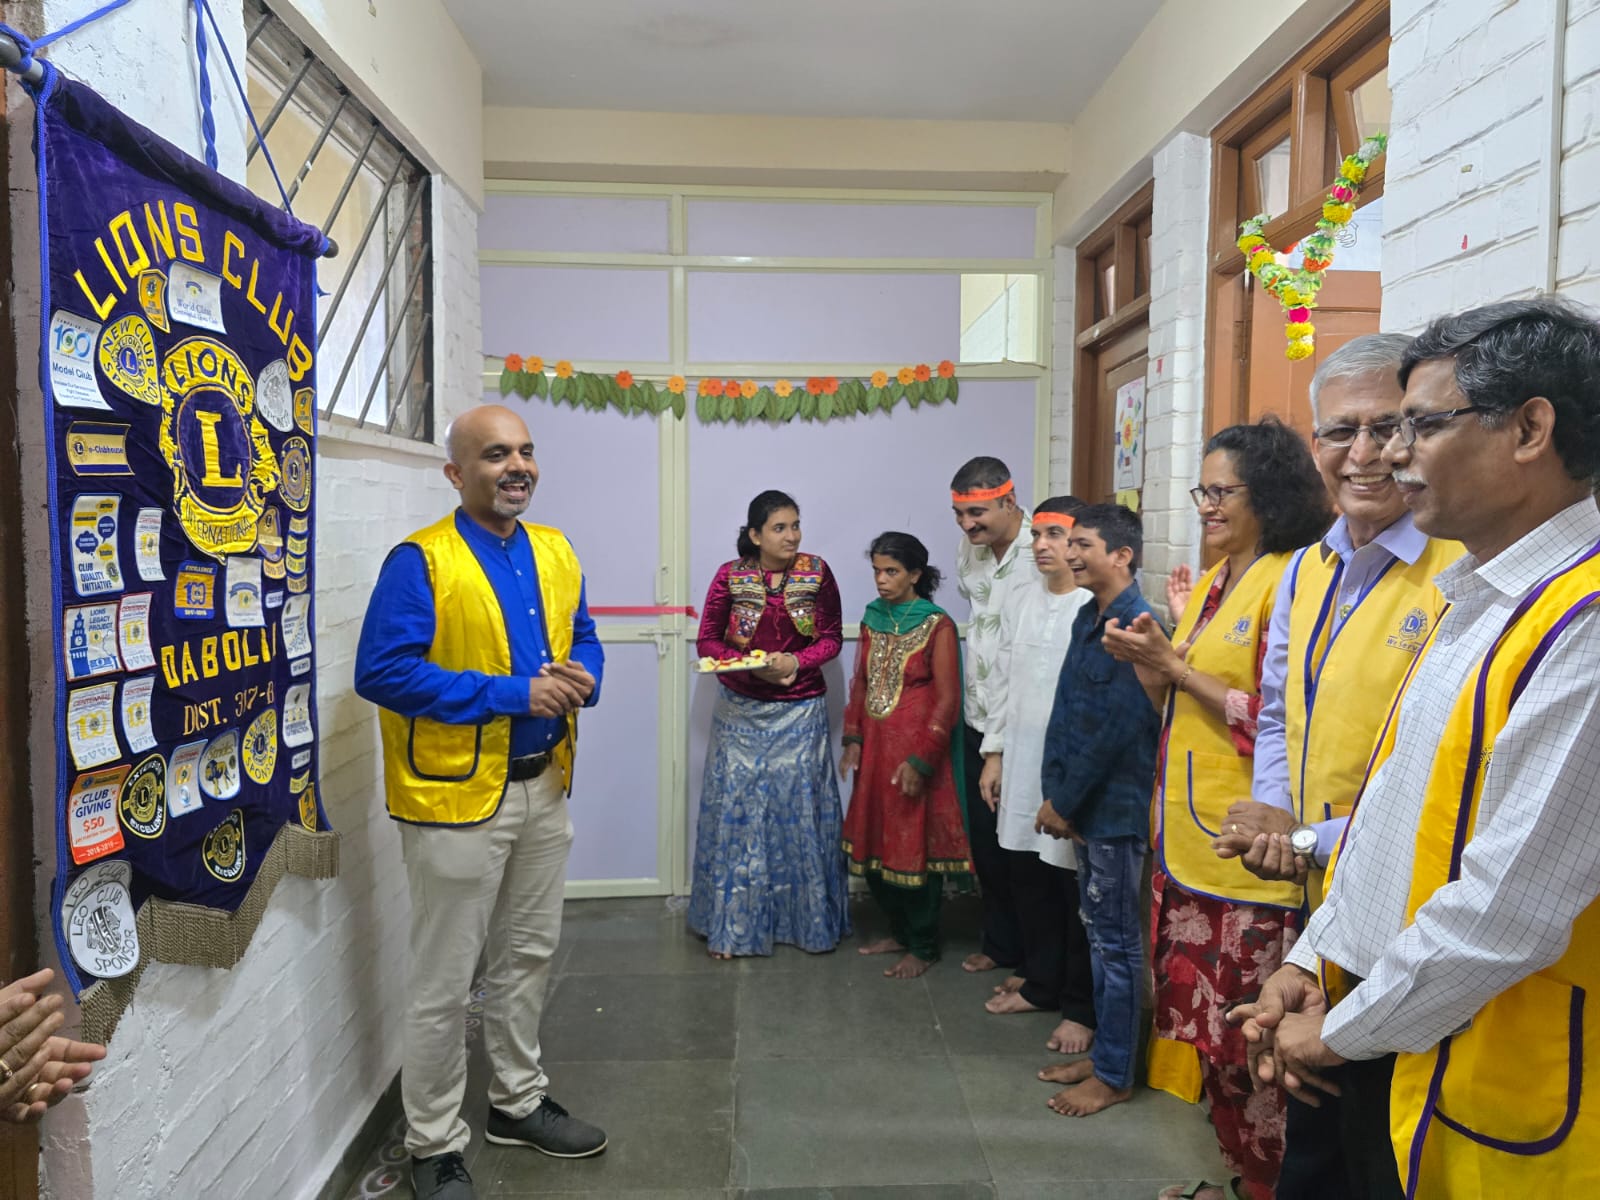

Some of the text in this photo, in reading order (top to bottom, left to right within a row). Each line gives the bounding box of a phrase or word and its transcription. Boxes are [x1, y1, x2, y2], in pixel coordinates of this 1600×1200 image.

[73, 200, 313, 381] LIONS CLUB
[103, 320, 155, 368] NEW CLUB
[53, 361, 92, 380] Model Club
[103, 362, 158, 402] SPONSOR
[169, 347, 250, 408] LIONS
[196, 410, 243, 488] L
[185, 501, 253, 545] INTERNATIONAL
[78, 563, 94, 572] CLUB
[80, 571, 105, 582] QUALITY
[82, 581, 113, 592] INITIATIVE
[88, 622, 113, 632] PROJECT
[89, 616, 110, 624] LEGACY
[90, 608, 107, 616] LIONS
[183, 697, 229, 735] DIST.
[245, 745, 277, 779] SPONSOR
[75, 799, 112, 818] GIVING
[81, 788, 110, 804] CLUB
[83, 816, 105, 833] $50
[130, 805, 163, 834] EXCELLENCE
[66, 864, 127, 909] LEO CLUB
[72, 905, 88, 937] LEO
[96, 886, 123, 906] CLUB
[95, 929, 136, 973] SPONSOR
